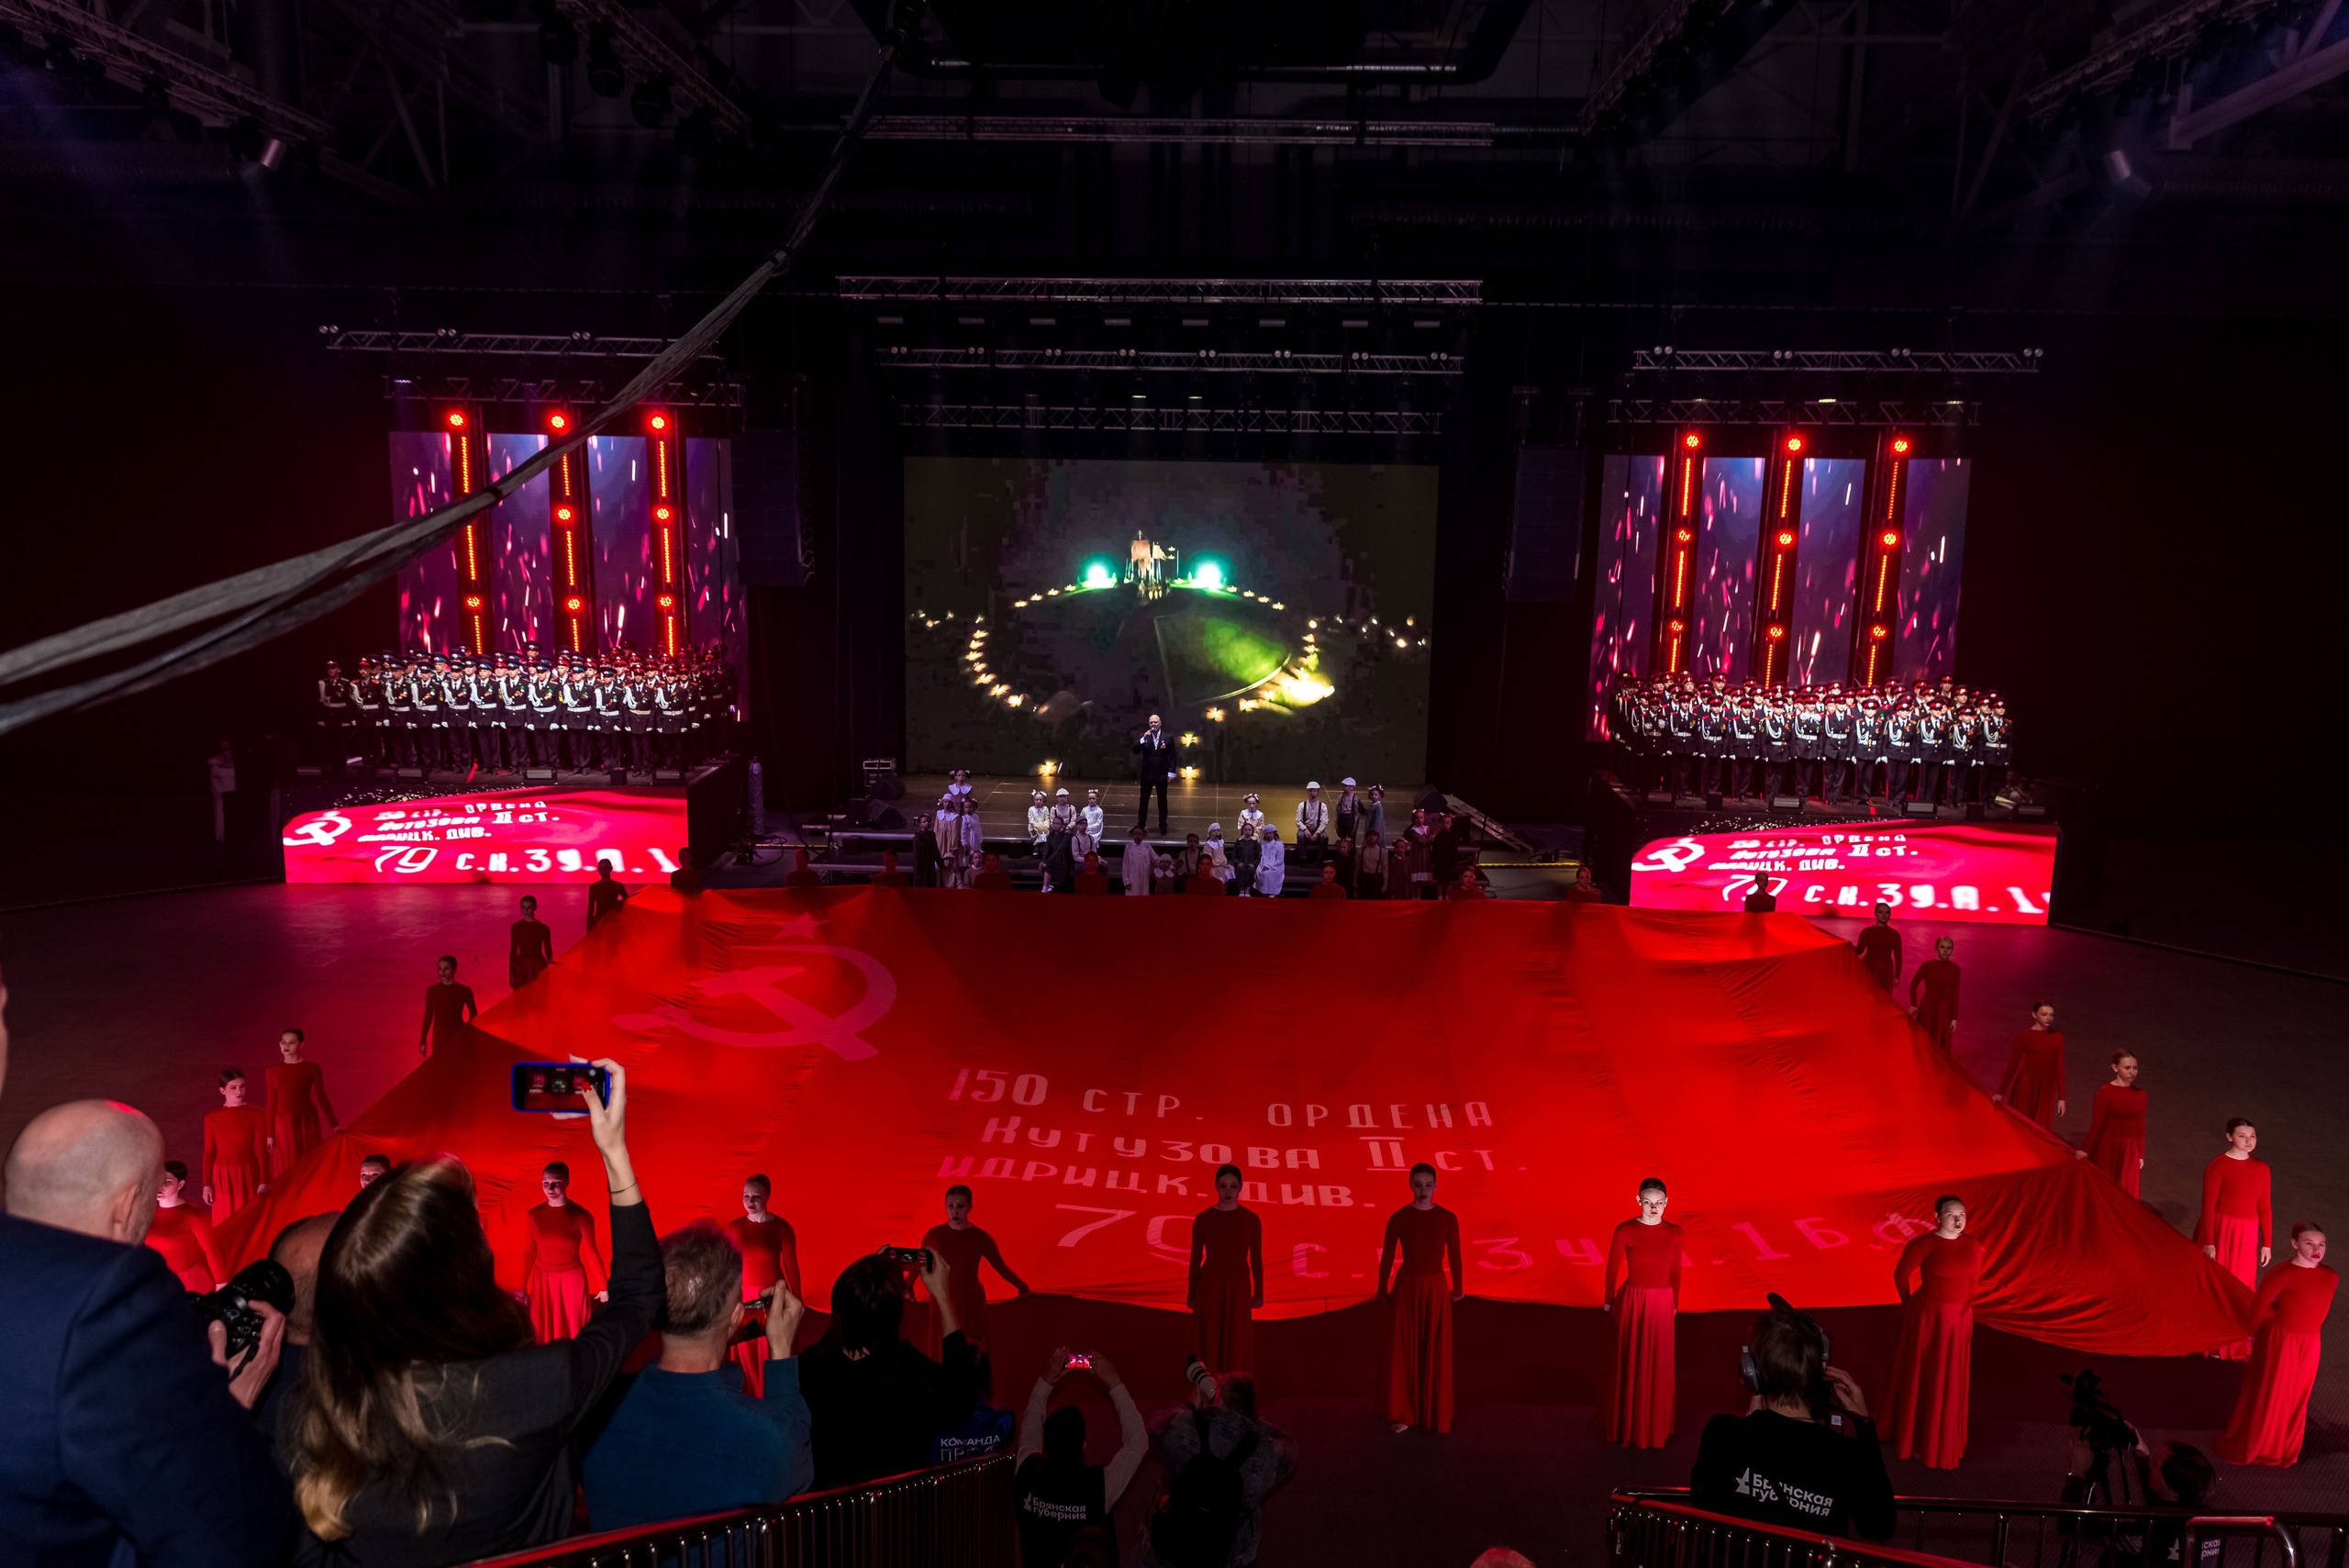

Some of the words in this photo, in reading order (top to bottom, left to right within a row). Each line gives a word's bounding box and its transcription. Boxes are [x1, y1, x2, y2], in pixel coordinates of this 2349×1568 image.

[374, 846, 439, 873] 79
[949, 1068, 1048, 1106] 150
[1267, 1101, 1493, 1129] ОРДЕНА
[937, 1156, 1208, 1197] ИДРИЦК.
[1238, 1181, 1375, 1208] ДИВ.
[941, 1434, 1000, 1448] КОМАНДА
[1752, 1487, 1831, 1517] губрния
[1753, 1473, 1833, 1507] Брнская
[1032, 1496, 1086, 1513] Брянская
[1033, 1507, 1086, 1521] губерния
